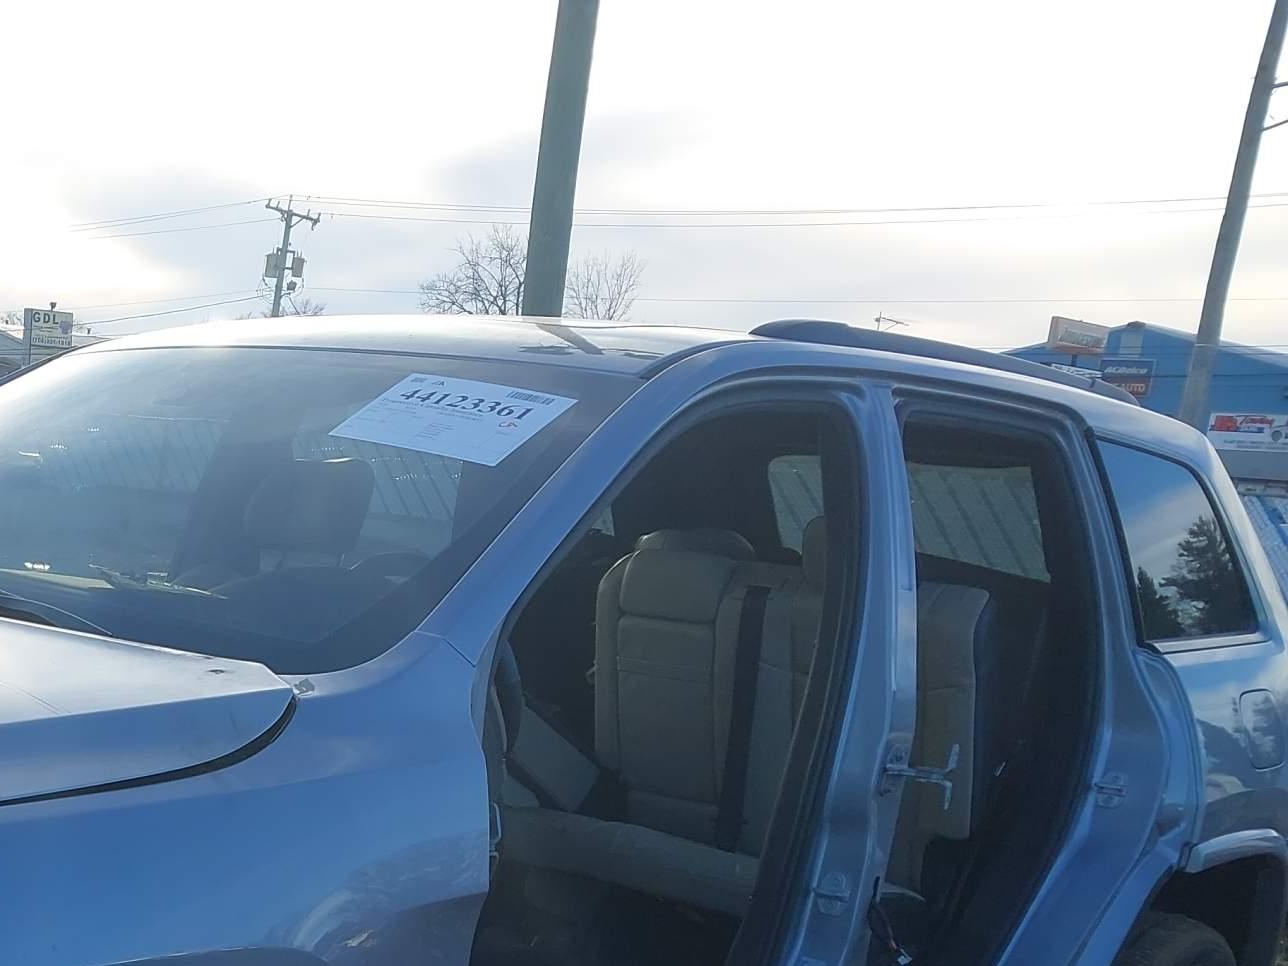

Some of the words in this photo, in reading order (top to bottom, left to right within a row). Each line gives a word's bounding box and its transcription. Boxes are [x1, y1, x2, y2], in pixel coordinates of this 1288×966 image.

[33, 312, 59, 324] GDL
[1104, 366, 1148, 374] ACDelco
[400, 389, 534, 420] 44123361
